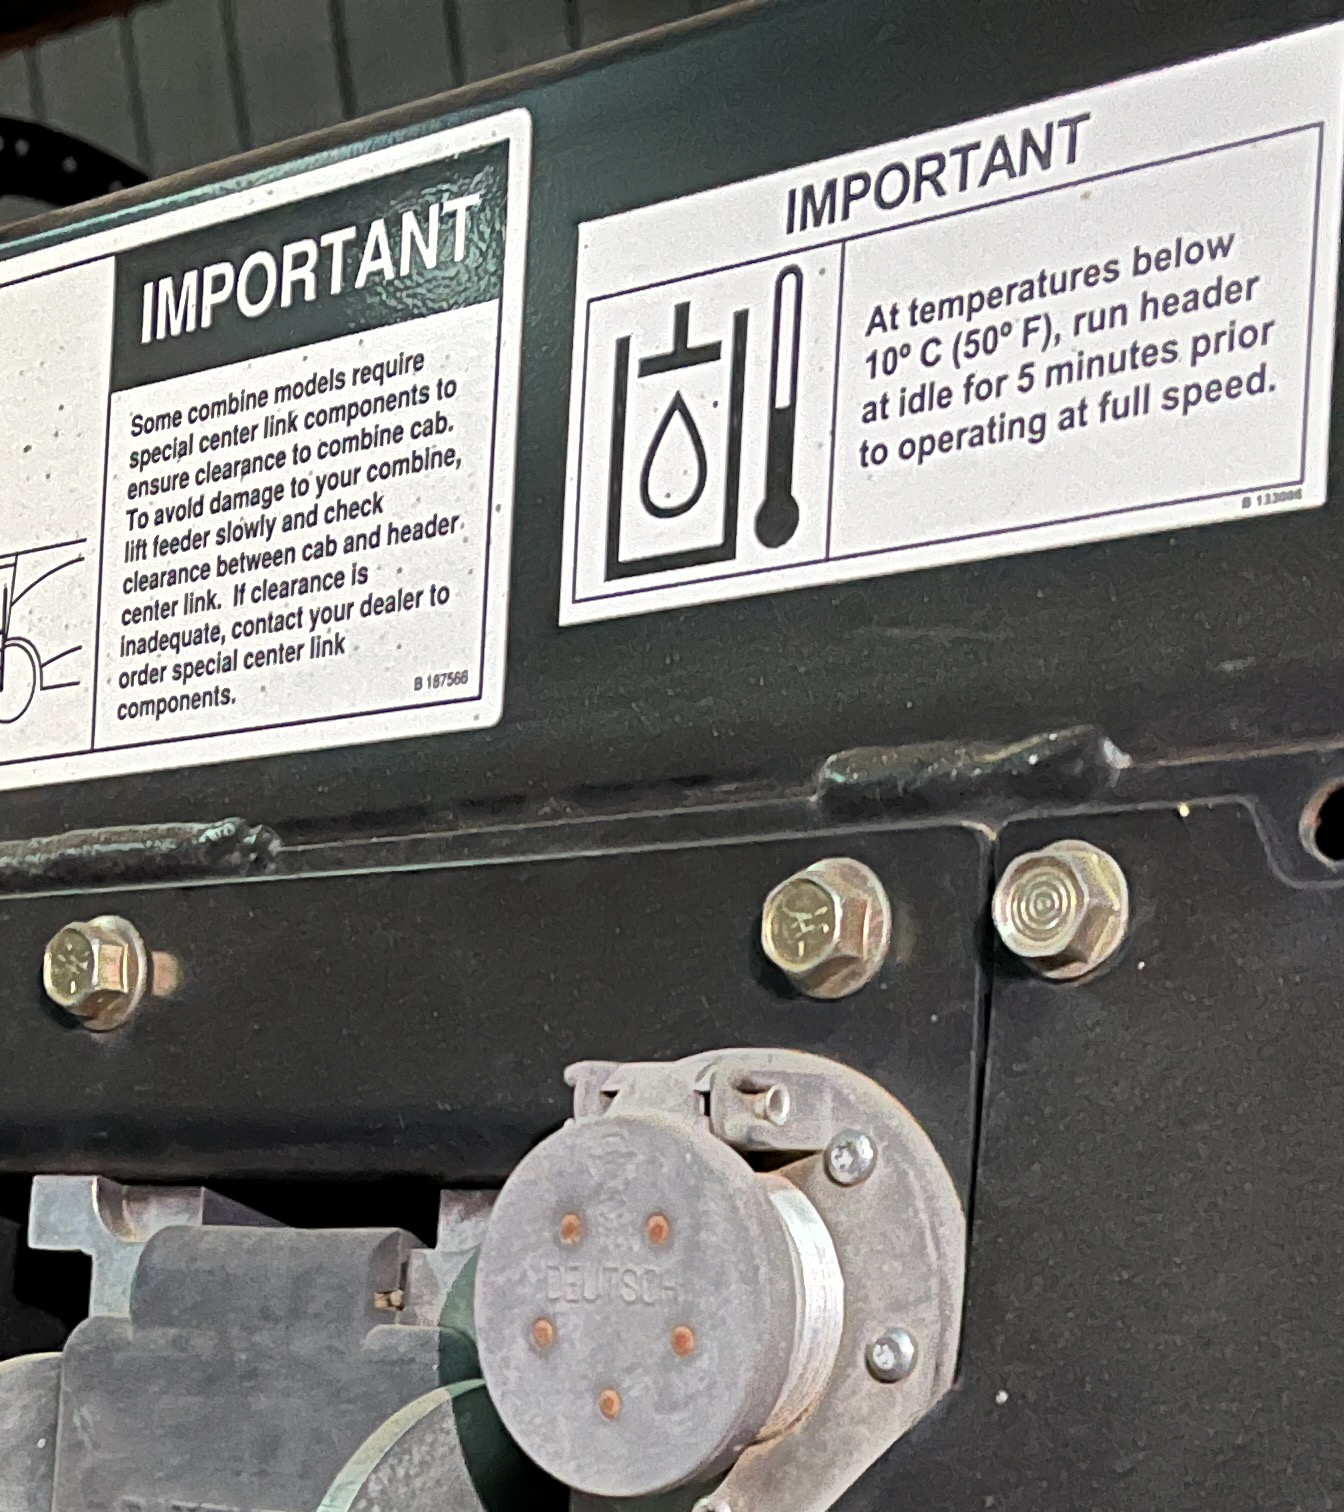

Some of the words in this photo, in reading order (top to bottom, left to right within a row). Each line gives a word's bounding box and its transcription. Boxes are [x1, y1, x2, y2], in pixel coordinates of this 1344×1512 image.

[785, 112, 1091, 235] IMPORTANT
[141, 194, 482, 344] IMPORTANT
[864, 302, 900, 338] At
[908, 259, 1120, 327] temperatures
[1132, 232, 1235, 277] below
[920, 337, 942, 368] C
[1022, 312, 1061, 353] F),
[1073, 303, 1128, 337] run
[1140, 275, 1260, 322] header
[130, 409, 183, 438] Some
[187, 388, 269, 425] combine
[274, 367, 346, 405] models
[352, 351, 425, 387] require
[859, 439, 888, 468] to
[898, 412, 1047, 466] operating
[1057, 397, 1088, 431] at
[1098, 383, 1150, 423] full
[1161, 362, 1276, 416] speed.
[861, 392, 890, 424] at
[899, 381, 953, 418] idle
[963, 372, 1009, 405] for
[1017, 361, 1035, 394] 5
[1045, 339, 1178, 388] minutes
[1190, 319, 1276, 367] prior
[127, 471, 190, 500] ensure
[194, 450, 287, 486] clearance
[292, 442, 312, 466] to
[317, 423, 404, 460] combine
[410, 410, 454, 440] cab.
[129, 432, 194, 473] special
[198, 423, 259, 454] center
[263, 410, 299, 439] link
[303, 383, 430, 430] components
[436, 377, 457, 401] to
[124, 538, 148, 564] lift
[152, 528, 211, 558] feeder
[215, 513, 277, 546] slowly
[281, 502, 319, 533] and
[323, 491, 384, 525] check
[125, 507, 150, 532] To
[153, 493, 205, 527] avoid
[209, 483, 285, 515] damage
[290, 476, 310, 499] to
[315, 466, 362, 500] your
[121, 599, 179, 627] center
[183, 588, 222, 616] link.
[233, 582, 246, 607] If
[250, 570, 346, 604] clearance
[351, 562, 369, 586] is
[122, 562, 211, 595] clearance
[216, 546, 296, 578] between
[301, 534, 338, 562] cab
[343, 524, 382, 555] and
[118, 662, 168, 690] order
[171, 648, 238, 686] special
[243, 642, 305, 670] center
[309, 632, 346, 660] link
[119, 622, 226, 658] inadequate,
[231, 606, 304, 640] contact
[309, 601, 355, 633] your
[359, 587, 424, 618] dealer
[429, 583, 450, 607] to
[117, 685, 236, 721] components.
[414, 676, 423, 691] B
